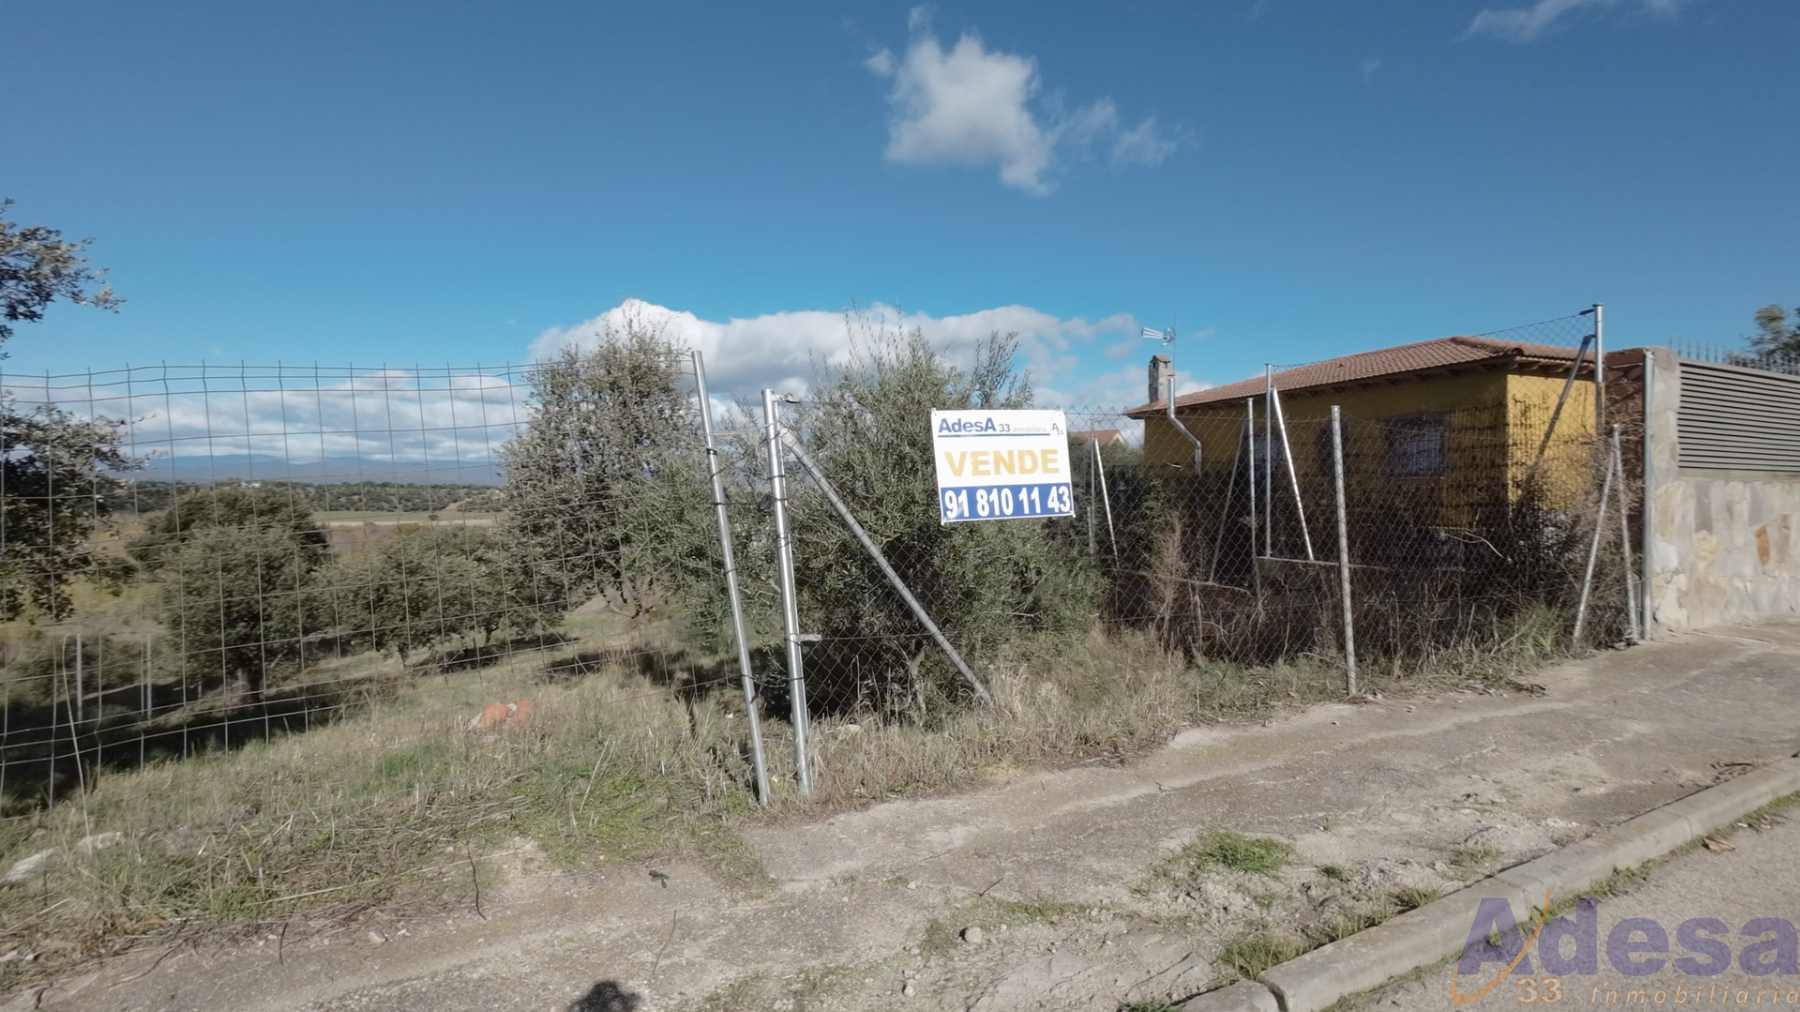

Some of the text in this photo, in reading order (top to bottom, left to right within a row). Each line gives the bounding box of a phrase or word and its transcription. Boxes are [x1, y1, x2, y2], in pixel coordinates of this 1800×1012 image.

[938, 417, 997, 433] AdesA
[998, 423, 1011, 433] 33
[943, 449, 1060, 477] VENDE
[944, 485, 1071, 519] 91 810 11 43
